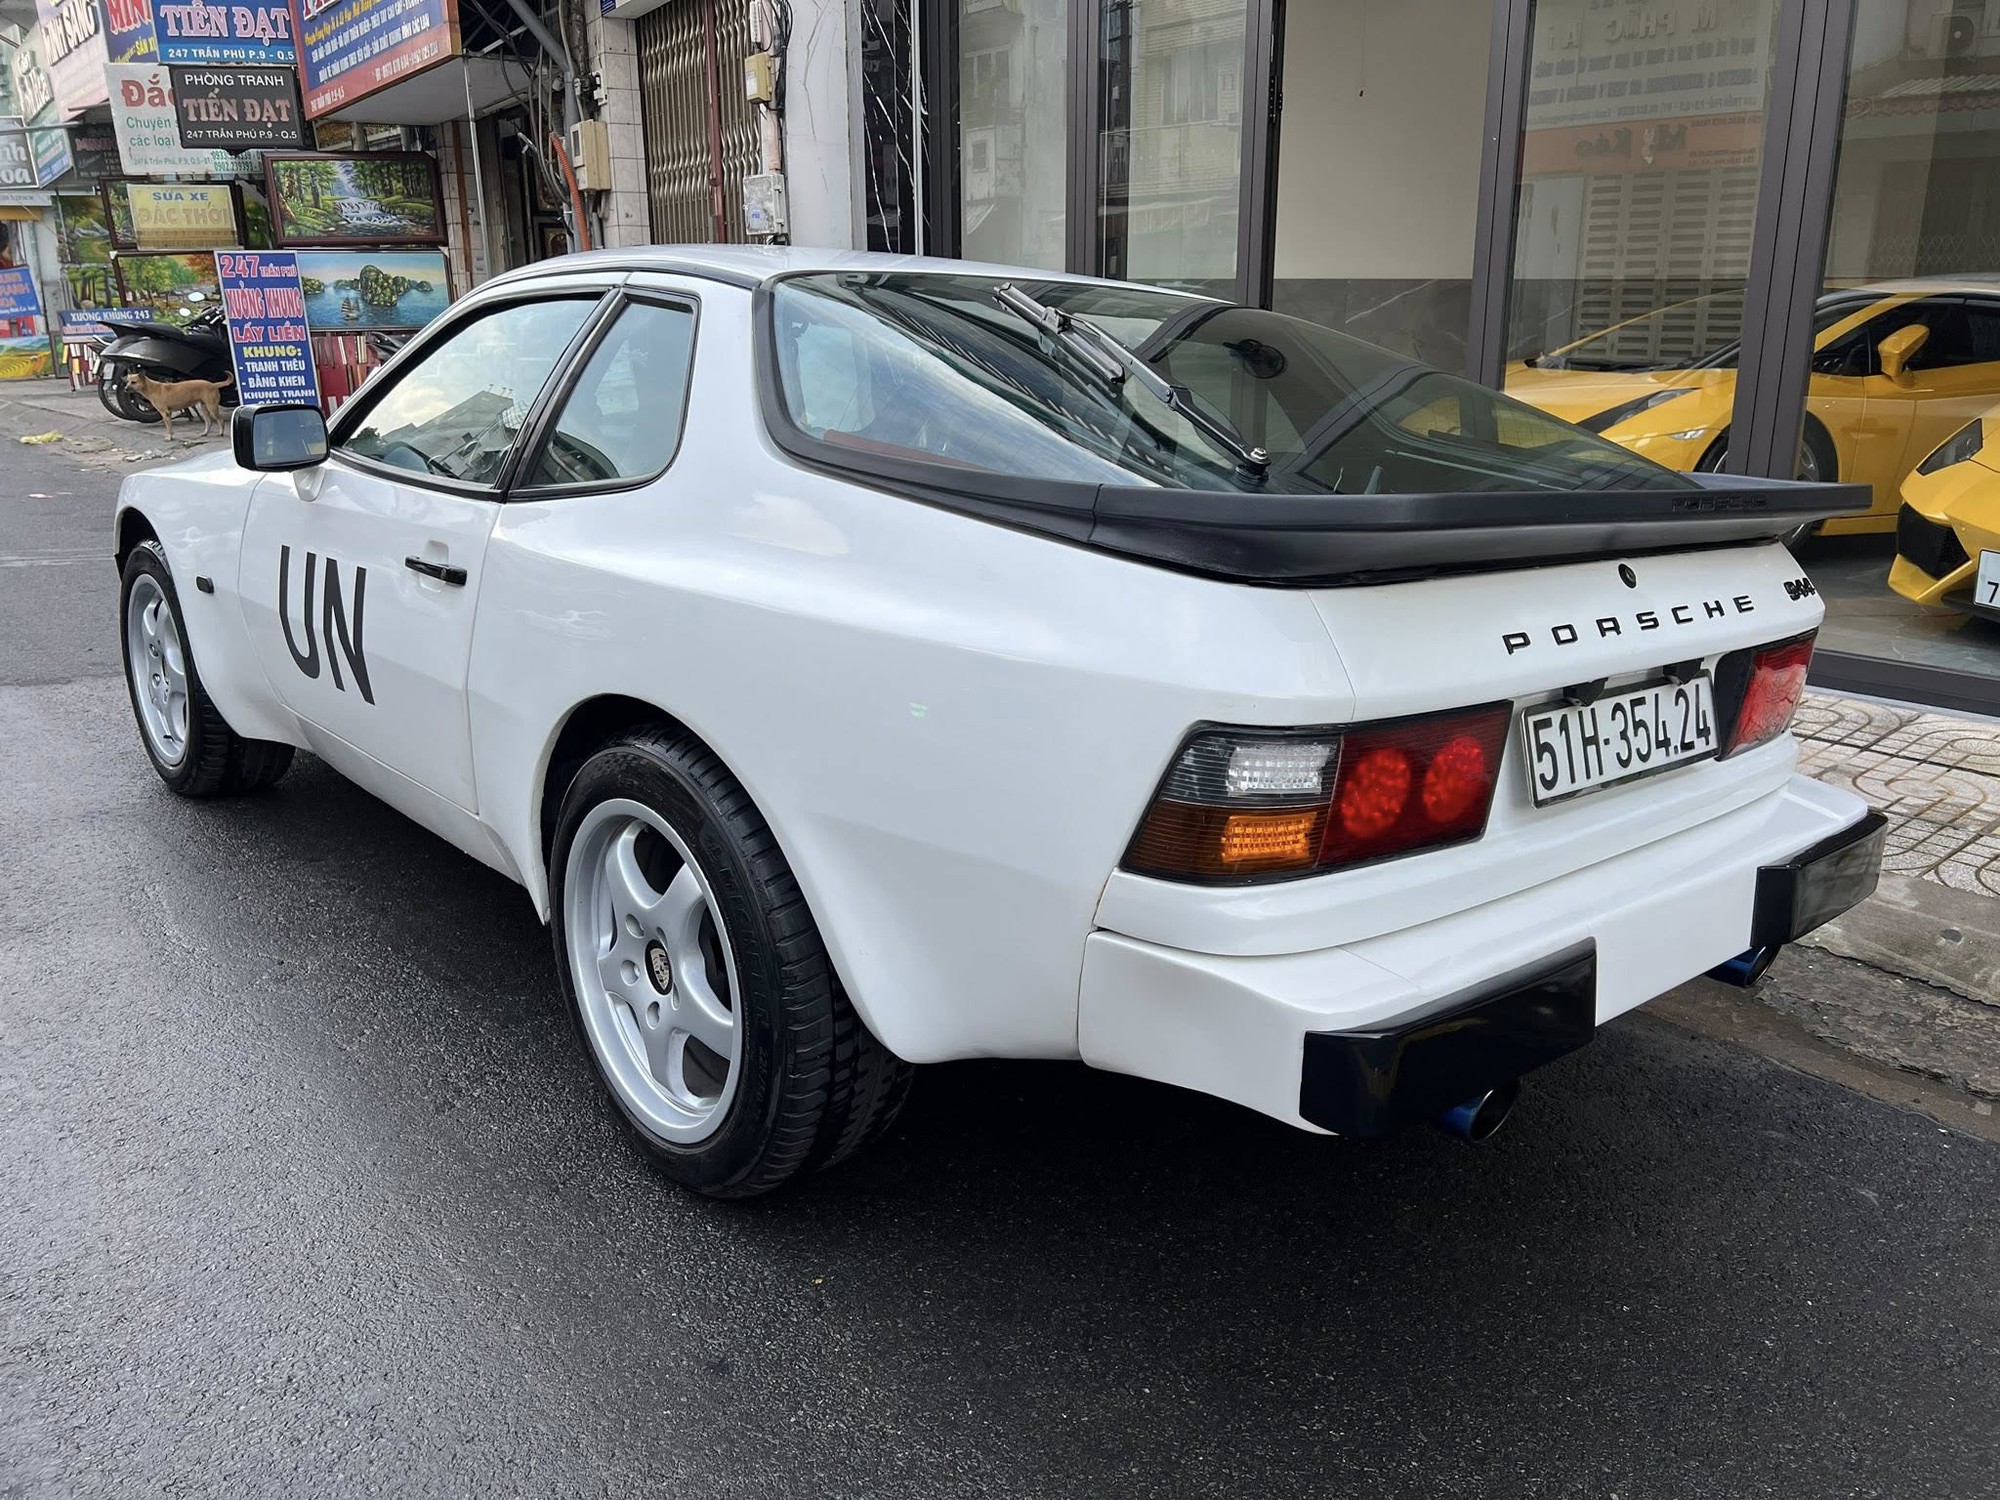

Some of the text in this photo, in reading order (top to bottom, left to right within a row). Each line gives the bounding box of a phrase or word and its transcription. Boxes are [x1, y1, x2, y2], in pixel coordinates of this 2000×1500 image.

[231, 7, 290, 46] ĐẠT
[168, 49, 188, 58] 247
[249, 50, 266, 59] P.9
[277, 50, 295, 60] Q.5
[185, 71, 284, 87] PHÒNG TRANH
[183, 88, 290, 128] TIẾN ĐẠT
[126, 116, 172, 130] Chuyên
[130, 134, 175, 147] các loại
[186, 130, 203, 138] 247
[259, 130, 272, 138] P.9
[281, 130, 298, 139] Q.5
[190, 192, 209, 201] XE
[220, 255, 259, 278] 247
[265, 288, 303, 319] KHUNG
[134, 310, 149, 319] 243
[233, 323, 264, 343] LẤY
[243, 345, 302, 358] KHUNG:
[246, 361, 278, 372] TRANH
[281, 359, 305, 371] THÊU
[248, 375, 277, 388] BẰNG
[280, 376, 305, 387] KHEN
[244, 389, 315, 400] KHUNG TRANH
[279, 544, 376, 706] UN
[1502, 595, 1755, 655] PORSCHE
[1532, 684, 1711, 791] 51H-354.24
